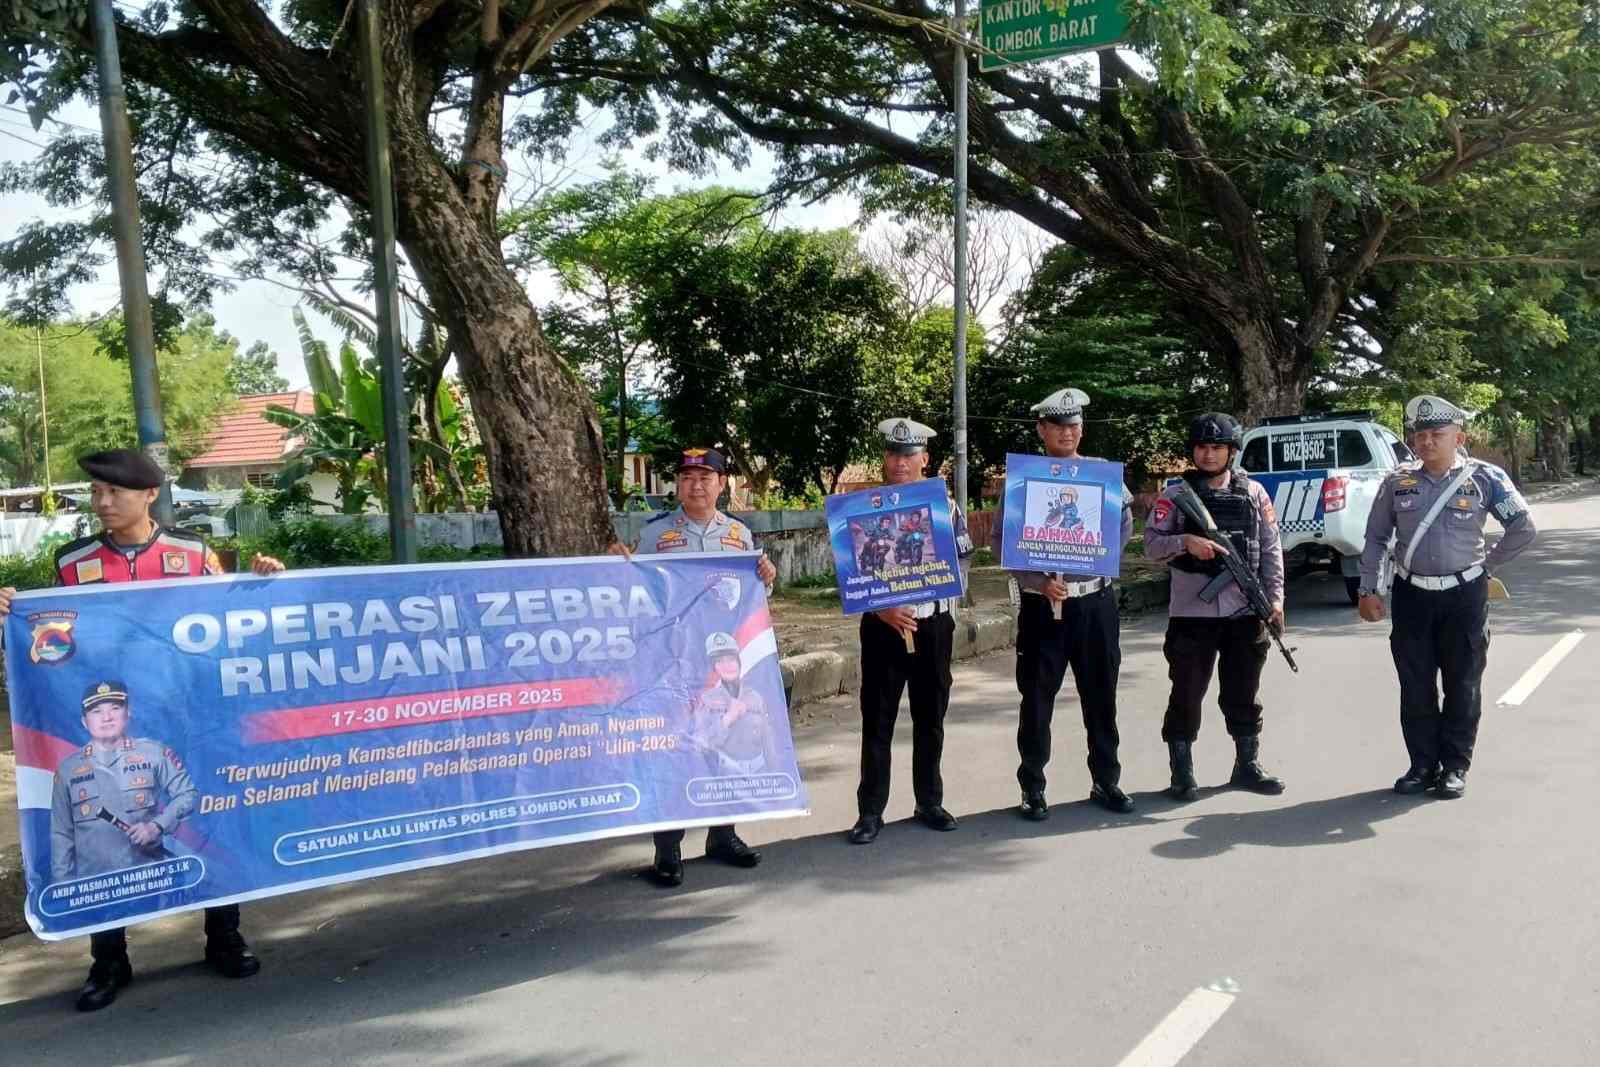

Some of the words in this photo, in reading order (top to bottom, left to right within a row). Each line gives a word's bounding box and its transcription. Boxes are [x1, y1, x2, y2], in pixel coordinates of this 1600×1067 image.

[986, 0, 1041, 24] KANTOR
[986, 27, 1042, 52] LOMBOK
[1050, 16, 1098, 43] BARAT
[1456, 488, 1480, 498] OLRI
[1017, 541, 1044, 551] JANGAN
[1044, 543, 1097, 555] MENGGUNAKAN
[1023, 524, 1103, 546] BAHAYA!
[890, 580, 923, 592] Belum
[924, 572, 956, 586] Nikah
[172, 594, 462, 655] OPERASI
[475, 585, 665, 628] ZEBRA
[220, 634, 488, 698] RINJANI
[504, 625, 638, 668] 2025
[331, 707, 389, 728] 17-30
[395, 691, 513, 719] NOVEMBER
[518, 687, 563, 705] 2025
[515, 725, 553, 745] yang
[558, 720, 604, 739] Aman,
[608, 714, 665, 734] Nyaman
[200, 794, 237, 815] Dan
[243, 778, 320, 807] Selamat
[324, 766, 417, 793] Menjelang
[422, 751, 528, 778] Pelaksanaan
[532, 746, 592, 768] Operasi
[296, 832, 360, 854] SATUAN
[363, 825, 402, 842] LALU
[406, 817, 458, 834] LINTAS
[461, 807, 517, 825] POLRES
[520, 798, 577, 815] LOMBOK
[580, 791, 624, 809] BARAT
[122, 865, 166, 885] HARAHAP
[69, 892, 111, 908] KAPOLRES
[111, 883, 147, 898] LOMBOK
[147, 877, 173, 891] BARAT
